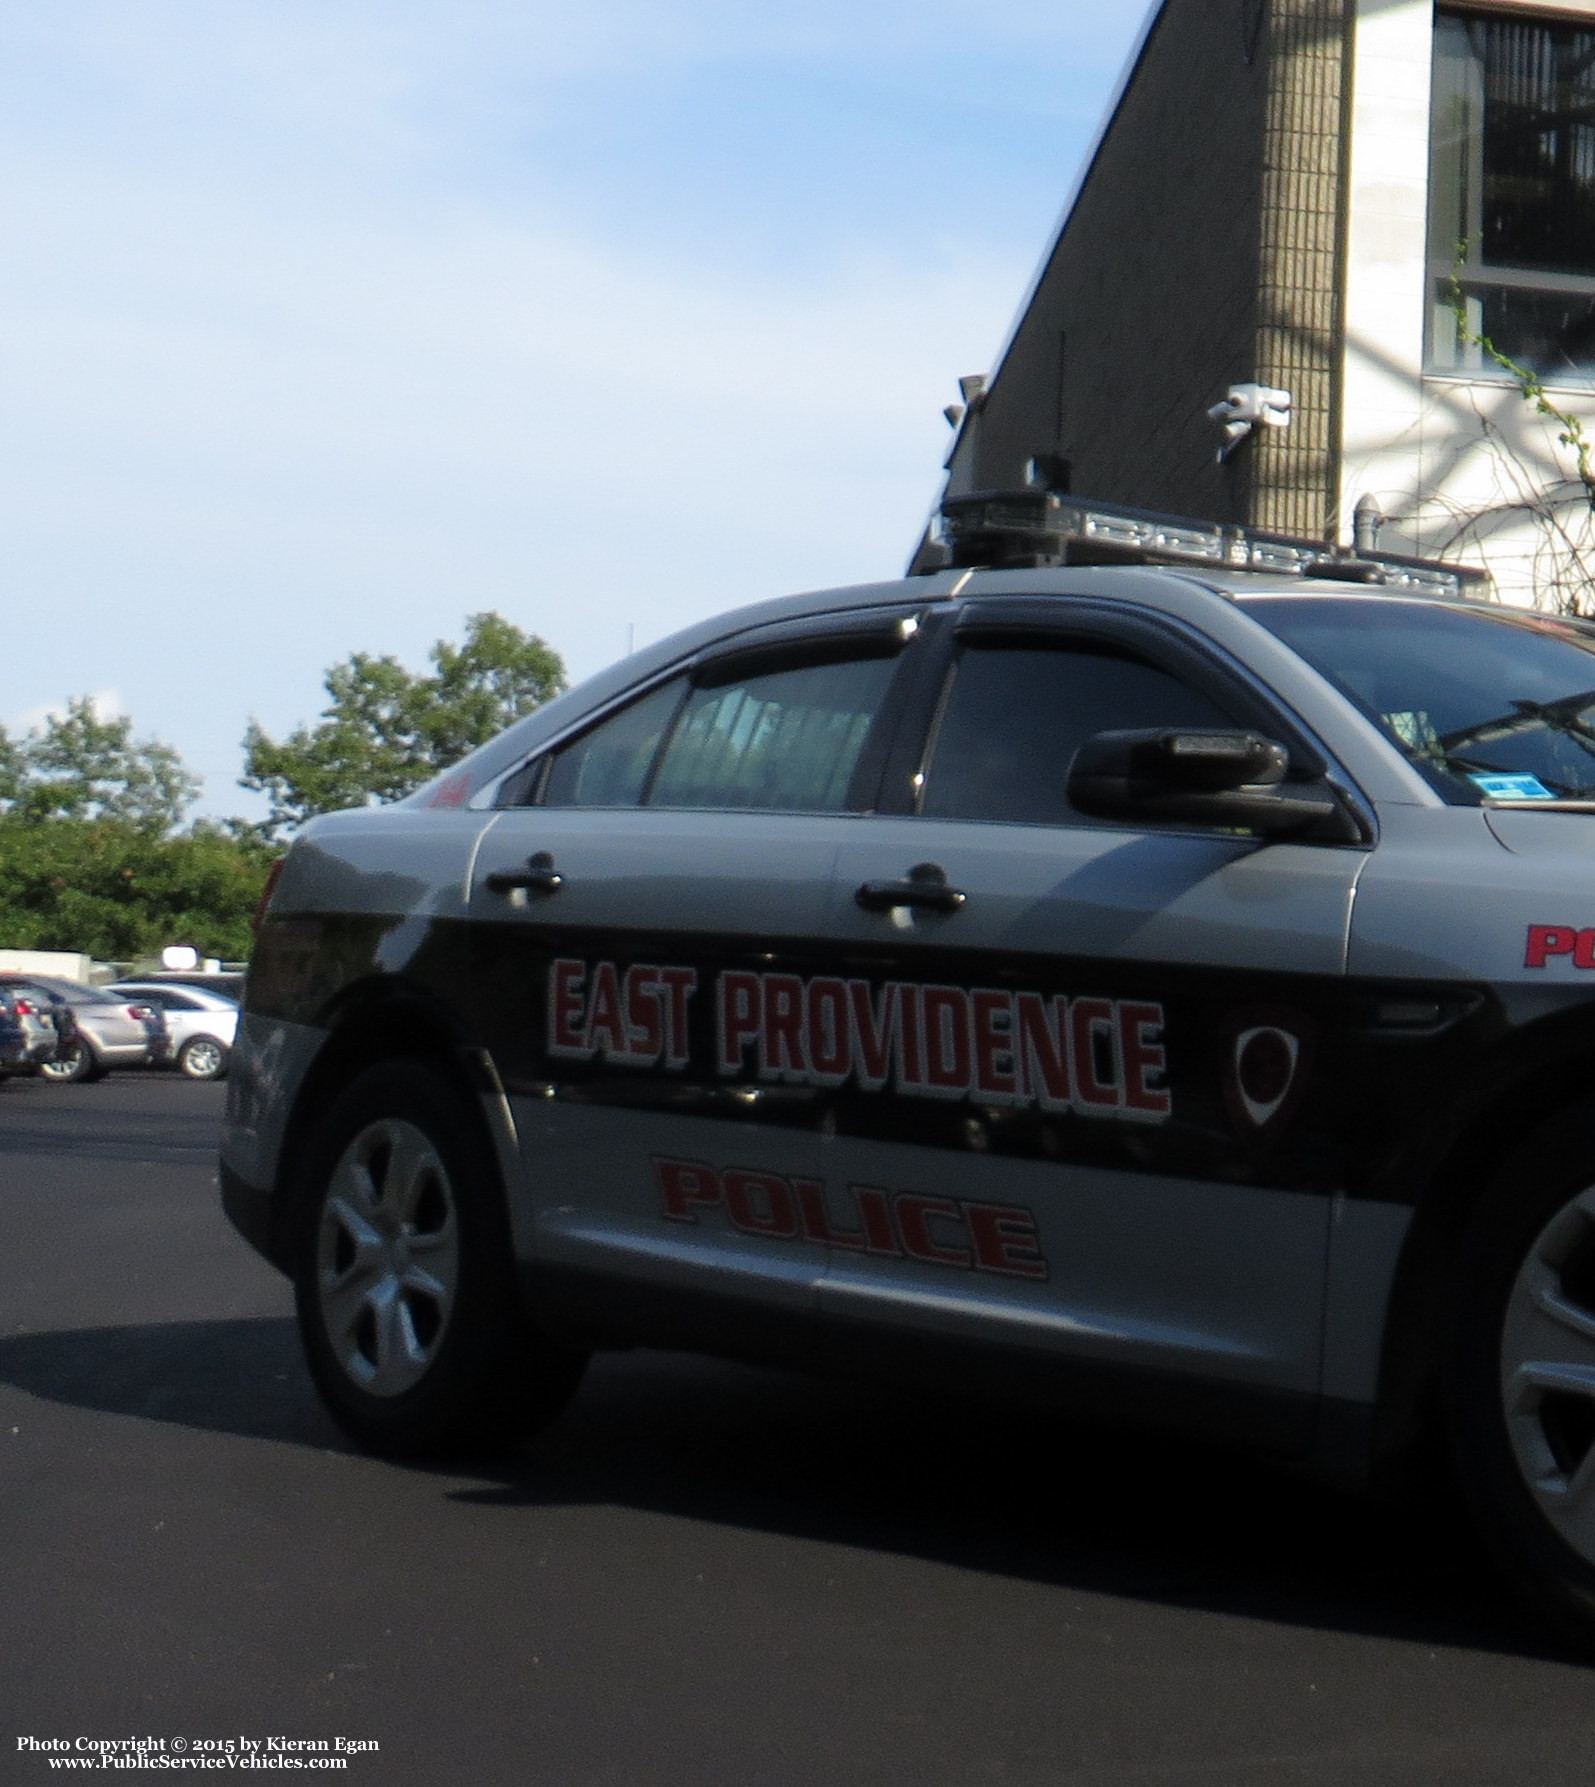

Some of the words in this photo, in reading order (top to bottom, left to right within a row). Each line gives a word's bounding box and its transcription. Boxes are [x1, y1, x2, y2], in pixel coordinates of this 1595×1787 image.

[548, 958, 696, 1069] EAST
[716, 971, 1171, 1125] PROVIDENCE
[650, 1155, 1048, 1280] POLICE
